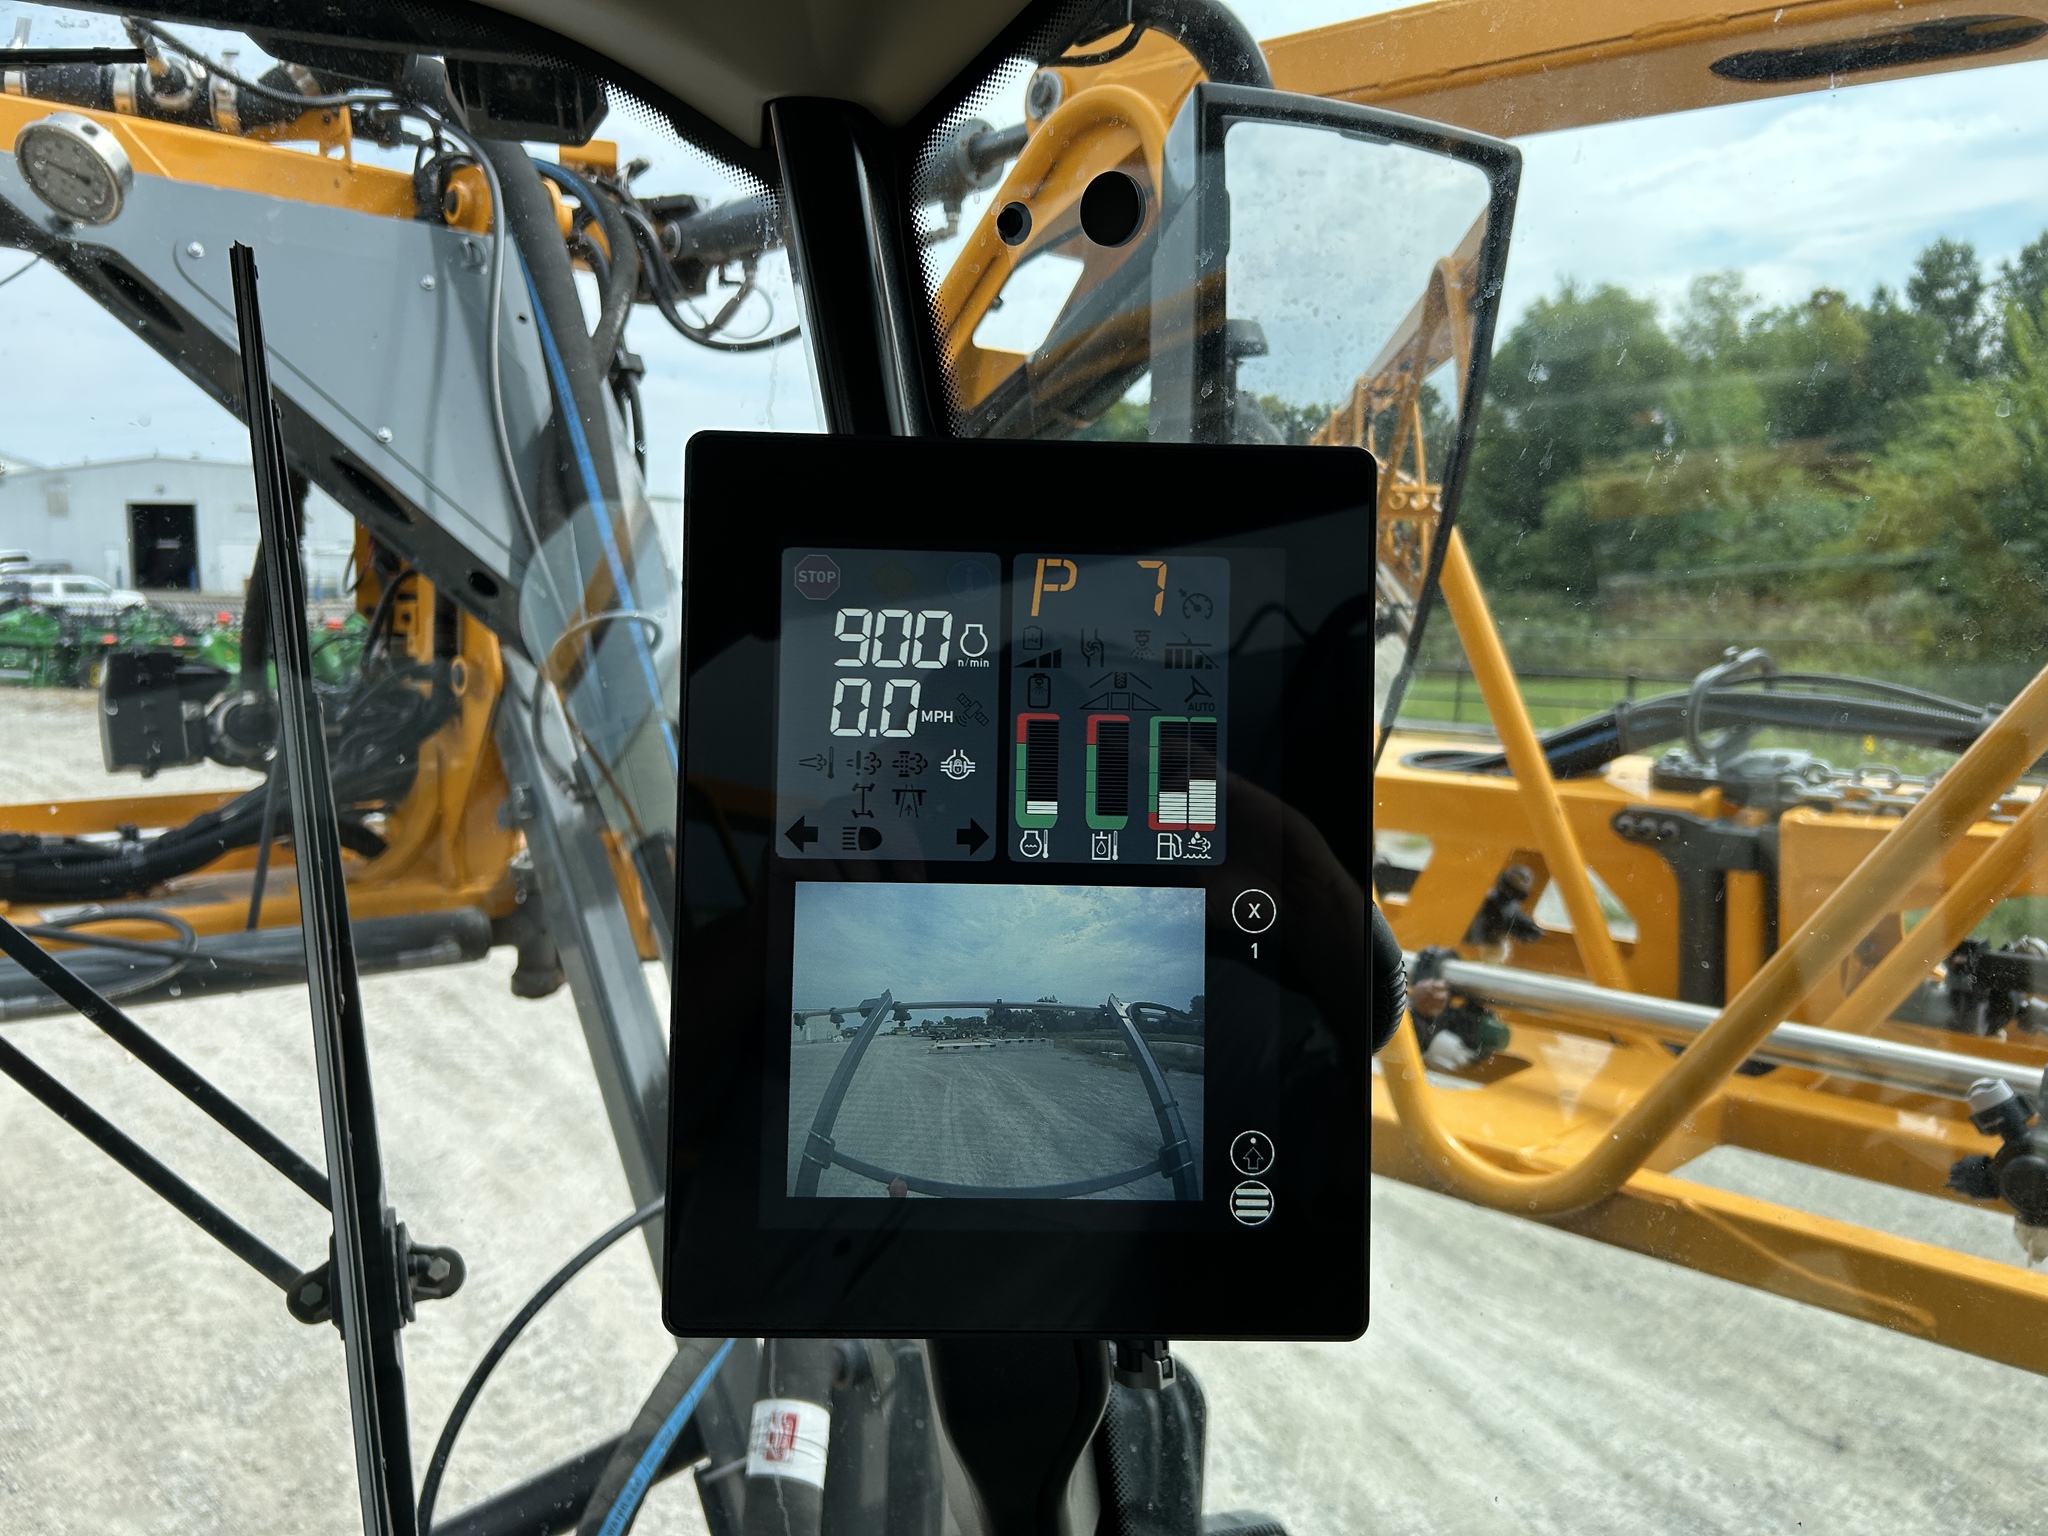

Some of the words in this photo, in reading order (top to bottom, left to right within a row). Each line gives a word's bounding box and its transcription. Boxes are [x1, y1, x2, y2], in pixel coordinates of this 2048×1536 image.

[798, 571, 837, 583] STOP
[1031, 558, 1078, 617] P
[1136, 560, 1167, 617] 7
[834, 608, 952, 669] 900
[958, 658, 990, 668] n/min
[830, 677, 921, 738] 0.0
[921, 711, 954, 724] MPH
[1187, 702, 1216, 713] AUTO
[1250, 942, 1258, 959] 1
